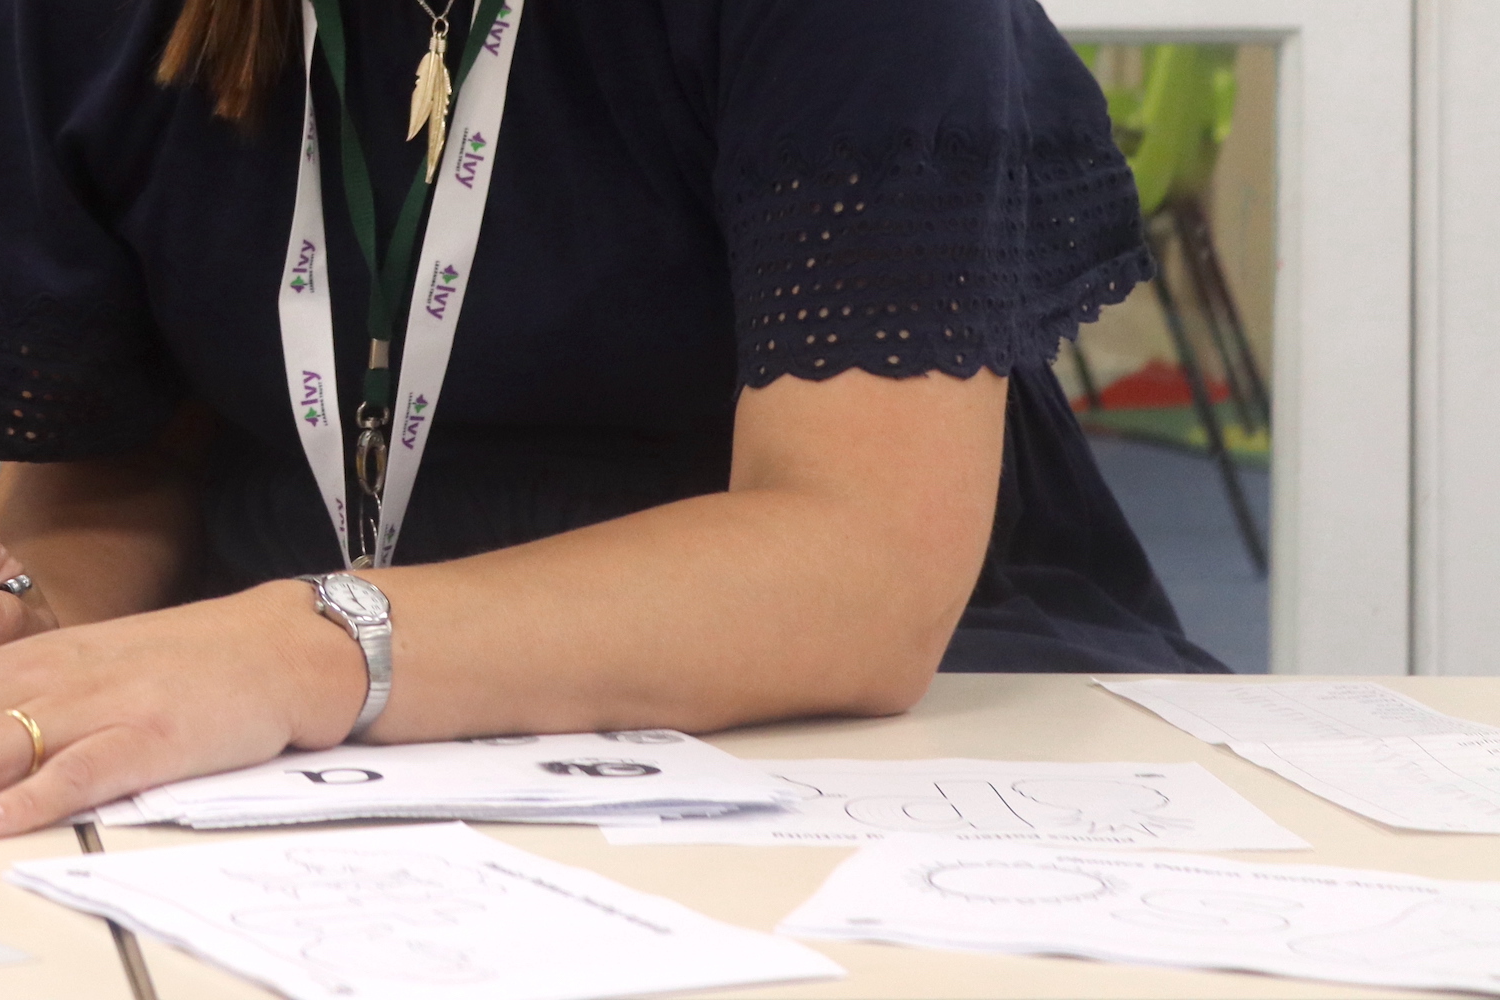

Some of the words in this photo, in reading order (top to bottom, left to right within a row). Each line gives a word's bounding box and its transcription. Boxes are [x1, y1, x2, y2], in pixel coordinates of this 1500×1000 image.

[482, 20, 510, 57] Ivy
[455, 152, 485, 189] Ivy
[292, 239, 316, 274] Ivy
[426, 283, 457, 320] Ivy
[300, 370, 322, 406] Ivy
[402, 415, 425, 450] Ivy
